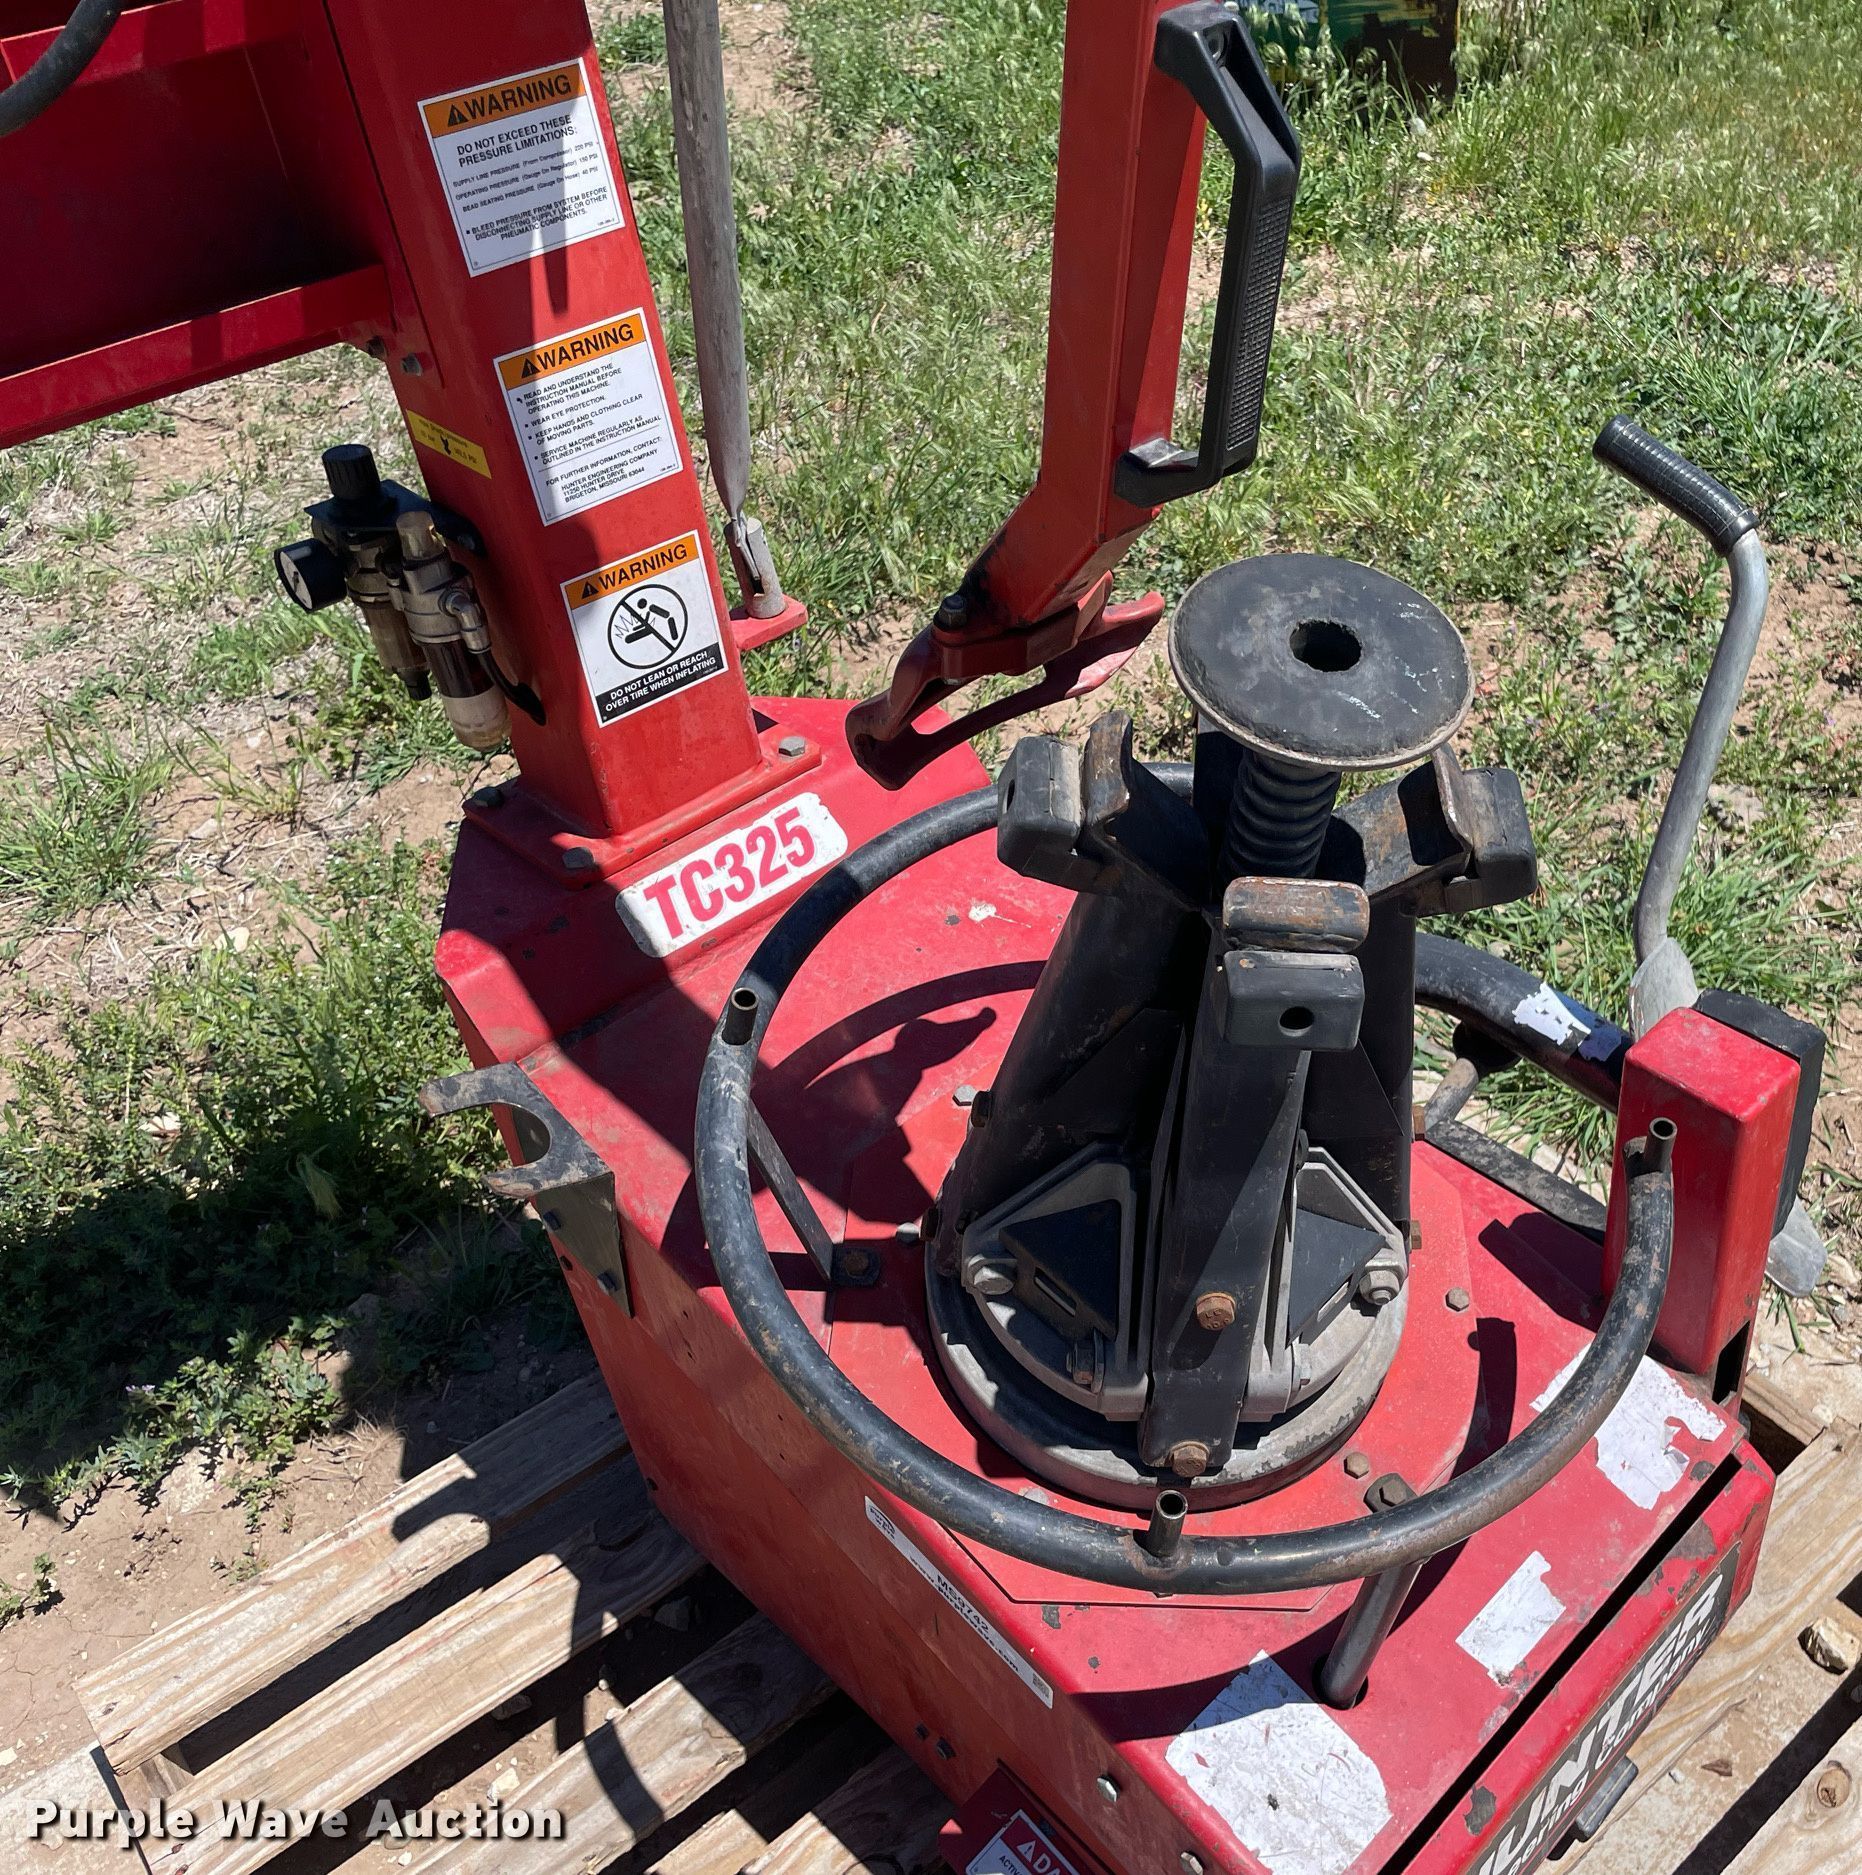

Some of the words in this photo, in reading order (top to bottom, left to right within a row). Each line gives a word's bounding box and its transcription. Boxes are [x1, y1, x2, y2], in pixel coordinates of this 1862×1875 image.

[464, 73, 571, 120] WARNING
[456, 142, 473, 155] DO
[474, 136, 495, 150] NOT
[497, 123, 538, 143] EXCEED
[539, 114, 571, 131] THESE
[458, 143, 513, 167] PRESSURE
[514, 124, 577, 150] LIMITATIONS:
[452, 176, 475, 187] SUPPLY
[475, 172, 489, 180] LINE
[490, 162, 520, 176] PRESSURE
[455, 186, 488, 200] OPERATING
[489, 176, 519, 190] PRESSURE
[588, 152, 598, 160] PSI
[462, 202, 479, 212] BEAD
[479, 194, 504, 206] SEATING
[504, 185, 534, 199] PRESSURE
[471, 221, 495, 234] BLEED
[495, 210, 532, 226] PRESSURE
[533, 203, 553, 214] FROM
[553, 194, 580, 208] SYSTEM
[581, 186, 607, 199] BEFORE
[474, 218, 530, 240] DISCONNECTING
[531, 209, 556, 222] SUPPLY
[557, 204, 573, 213] LINE
[573, 200, 583, 208] OR
[584, 193, 607, 205] OTHER
[500, 222, 539, 240] PNEUMATIC
[540, 207, 587, 227] COMPONENTS.
[536, 322, 633, 371] WARNING
[523, 389, 542, 400] READ
[542, 384, 556, 393] AND
[557, 368, 599, 387] UNDERSTAND
[600, 362, 613, 371] THE
[525, 387, 568, 407] INSTRUCTION
[569, 377, 595, 391] MANUAL
[596, 367, 622, 381] BEFORE
[527, 397, 564, 415] OPERATING
[565, 391, 580, 400] THIS
[530, 415, 550, 427] WEAR
[551, 410, 563, 419] EYE
[534, 427, 552, 439] KEEP
[553, 419, 575, 432] HANDS
[576, 413, 589, 423] AND
[590, 401, 621, 417] CLOTHING
[622, 393, 642, 405] CLEAR
[536, 437, 546, 445] OF
[546, 427, 572, 441] MOVING
[572, 419, 594, 431] PARTS.
[540, 444, 567, 459] SERVICE
[568, 433, 597, 448] MACHINE
[597, 418, 633, 436] REGULARLY
[542, 448, 574, 465] OUTLINED
[582, 440, 594, 449] THE
[595, 424, 635, 444] INSTRUCTION
[545, 476, 559, 486] FOR
[560, 464, 589, 480] FURTHER
[561, 477, 586, 491] HUNTER
[587, 460, 628, 480] ENGINEERING
[628, 448, 657, 464] COMPANY
[580, 476, 605, 489] HUNTER
[606, 468, 624, 479] DRIVE
[598, 473, 627, 489] MISSOURI
[598, 543, 687, 590] WARNING
[605, 695, 629, 712] OVER
[629, 686, 649, 700] TIRE
[649, 674, 674, 691] WHEN
[675, 656, 715, 680] INFLATING
[610, 688, 623, 699] DO
[624, 680, 642, 693] NOT
[643, 669, 665, 685] LEAN
[665, 663, 678, 674] OR
[679, 650, 707, 668] REACH
[643, 807, 815, 940] TC325
[910, 1555, 1018, 1672] www.purplewave.com
[937, 1574, 988, 1634] MS9742
[1595, 1616, 1714, 1769] Company
